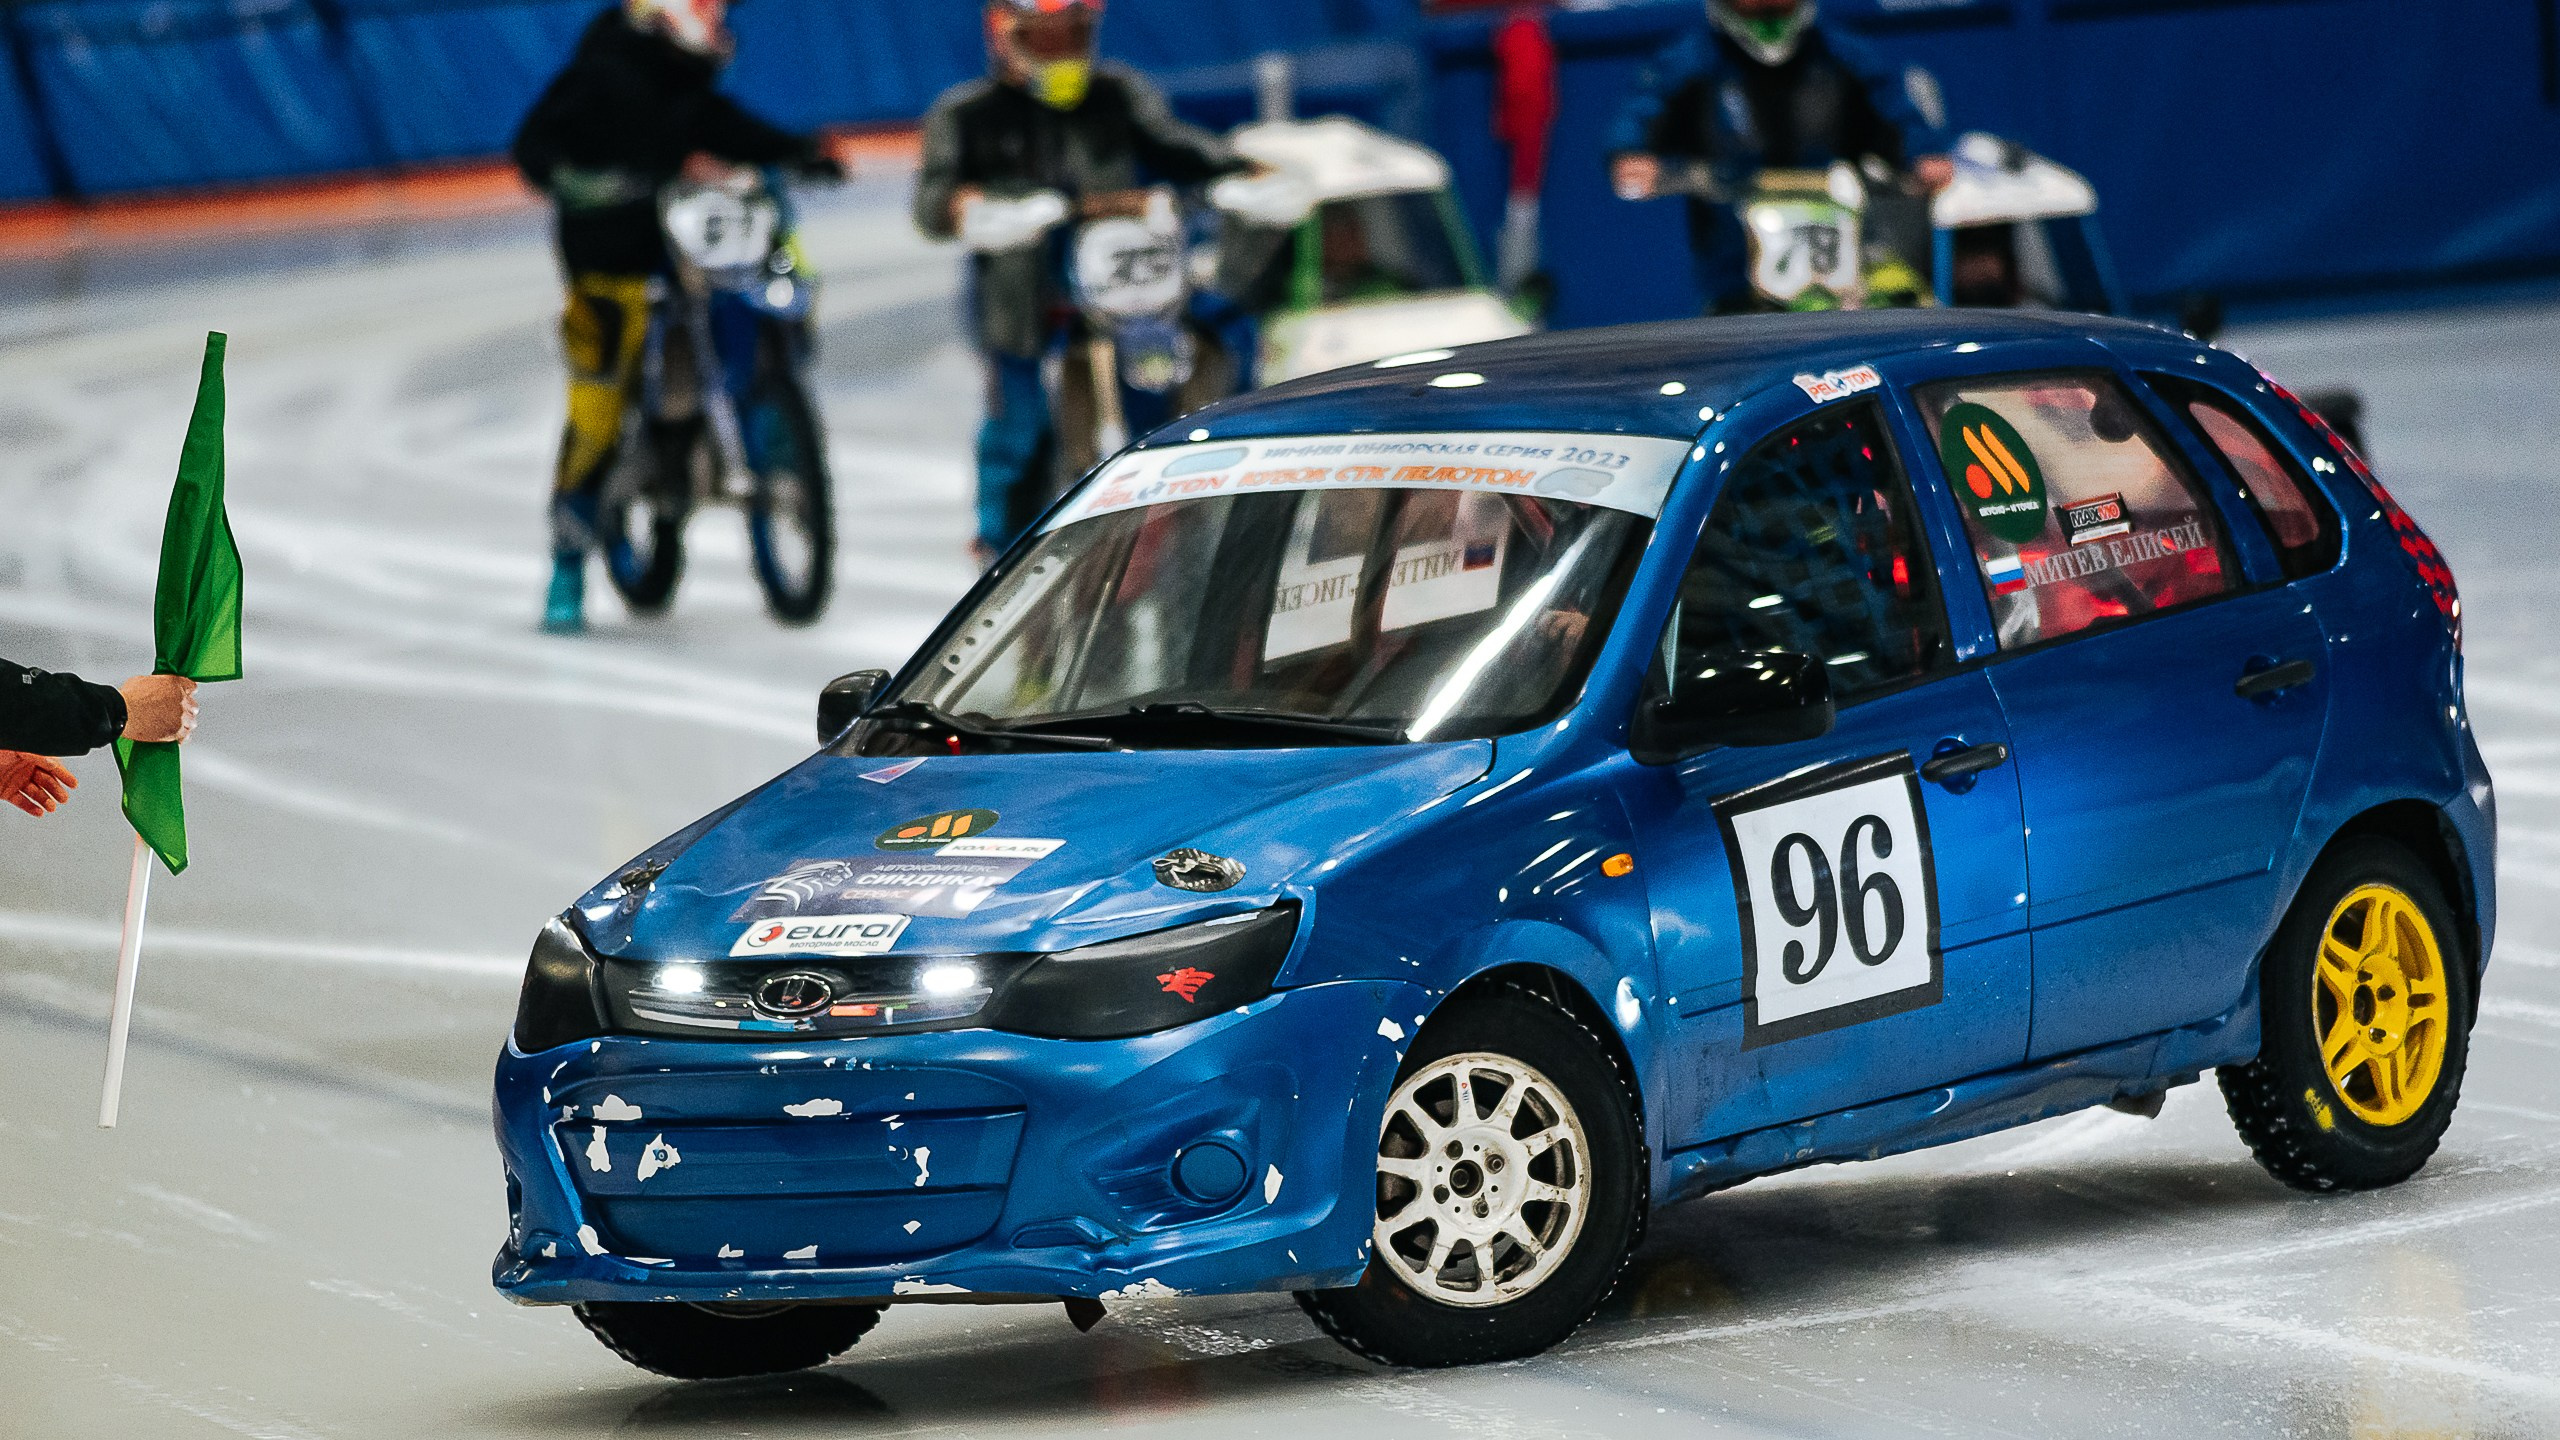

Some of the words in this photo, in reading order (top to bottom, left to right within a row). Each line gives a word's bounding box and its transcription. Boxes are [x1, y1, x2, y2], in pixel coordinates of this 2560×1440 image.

[1483, 443, 1554, 459] СЕРИЯ
[1557, 446, 1631, 470] 2023
[1392, 464, 1537, 488] ПЕЛОТОН
[2023, 548, 2108, 588] МИТЕВ
[2108, 515, 2206, 567] ЕЛИСЕЙ
[872, 864, 999, 873] АВТОКОМПЛЕКС
[1770, 813, 1905, 986] 96
[786, 917, 906, 940] eurol
[844, 939, 880, 948] масла
